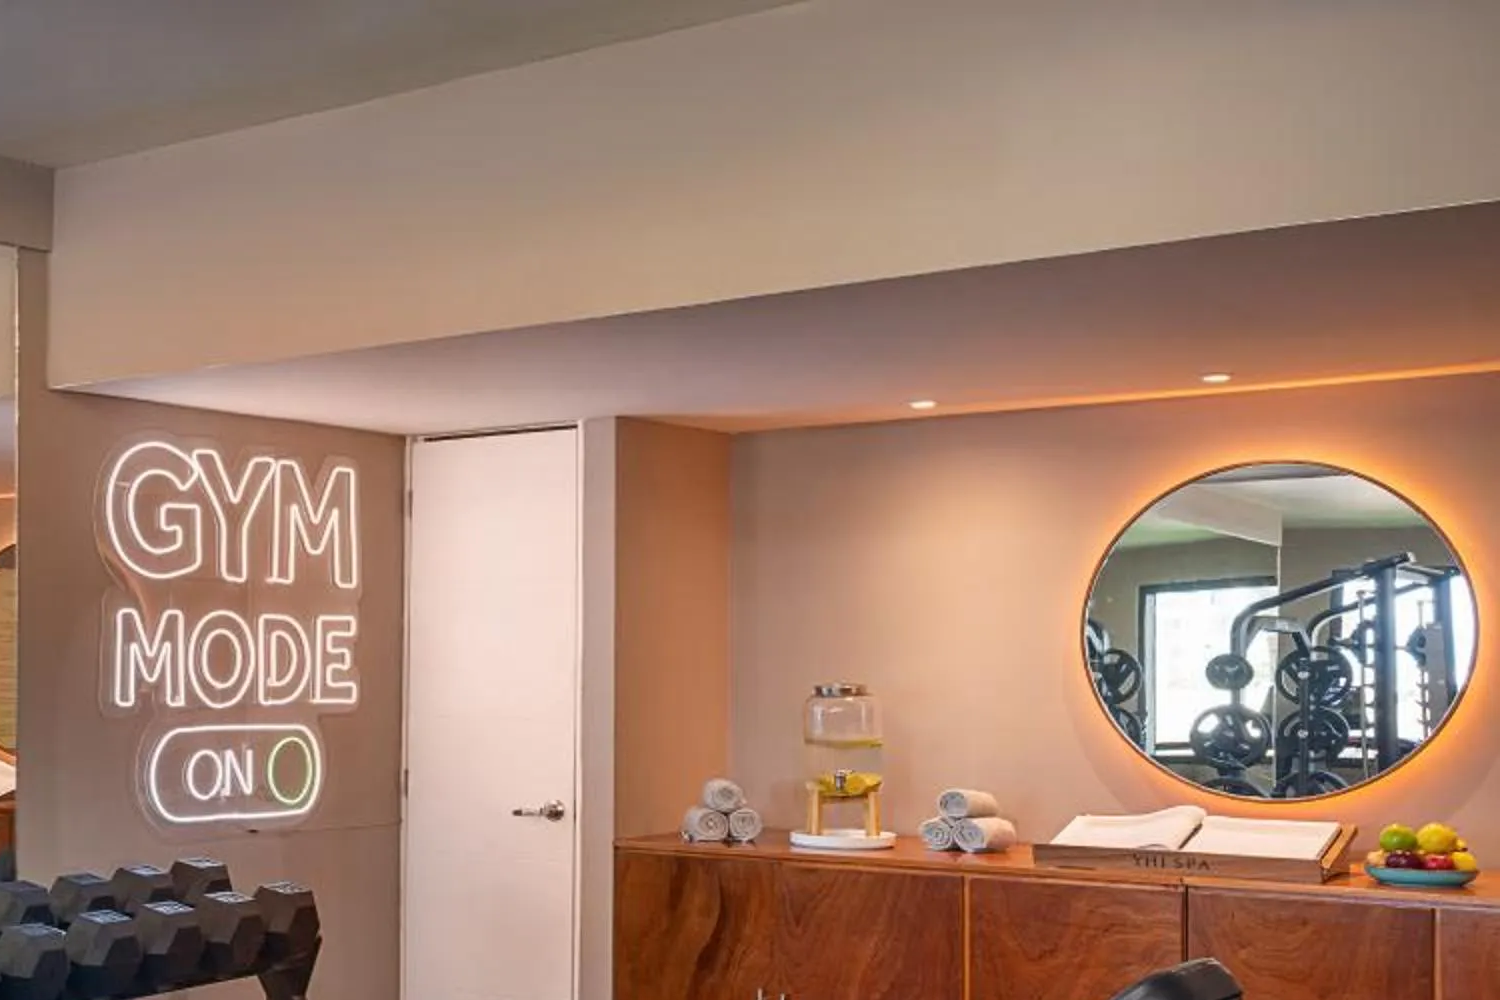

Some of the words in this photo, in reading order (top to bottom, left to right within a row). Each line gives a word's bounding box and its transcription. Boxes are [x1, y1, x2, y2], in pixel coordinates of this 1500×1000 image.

[106, 440, 358, 589] GYM
[114, 608, 358, 708] MODE
[187, 748, 253, 801] ON
[1172, 855, 1211, 871] SPA
